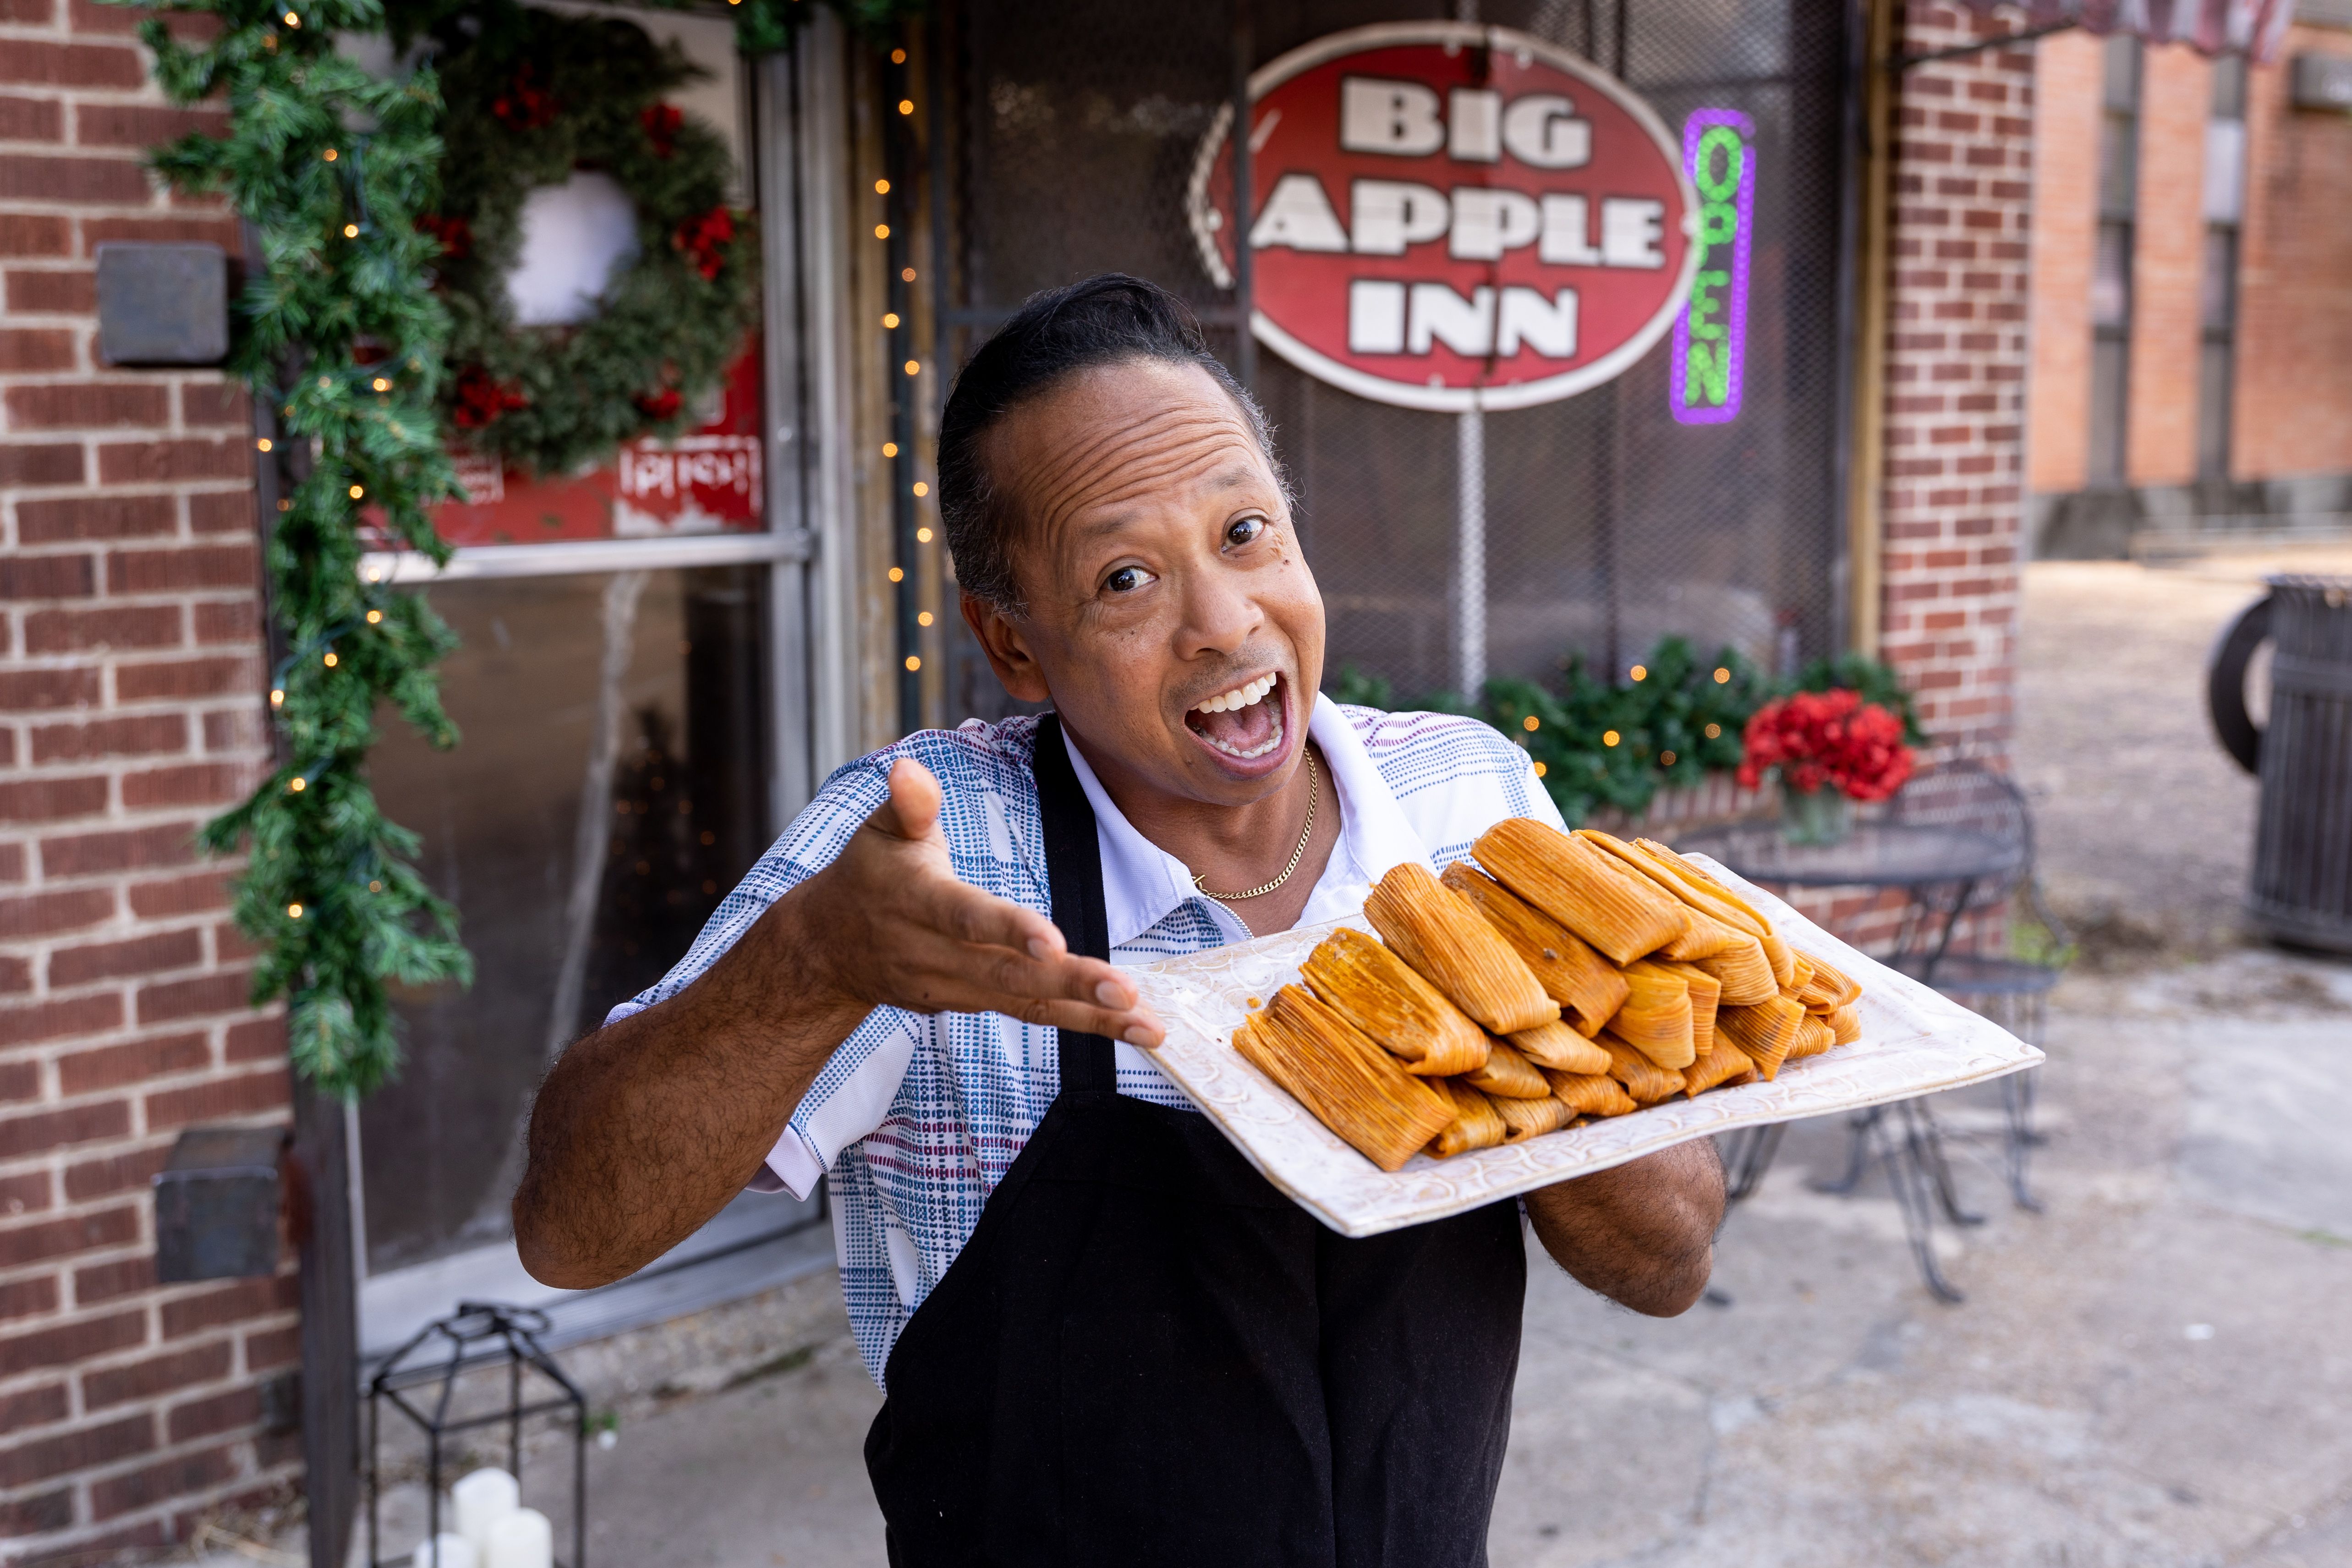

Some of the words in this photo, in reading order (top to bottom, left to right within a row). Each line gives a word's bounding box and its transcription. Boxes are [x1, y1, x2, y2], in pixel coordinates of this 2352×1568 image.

[1341, 77, 1591, 169] BIG
[1249, 174, 1664, 269] APPLE
[1685, 126, 1742, 406] OPEN
[1349, 280, 1578, 358] INN
